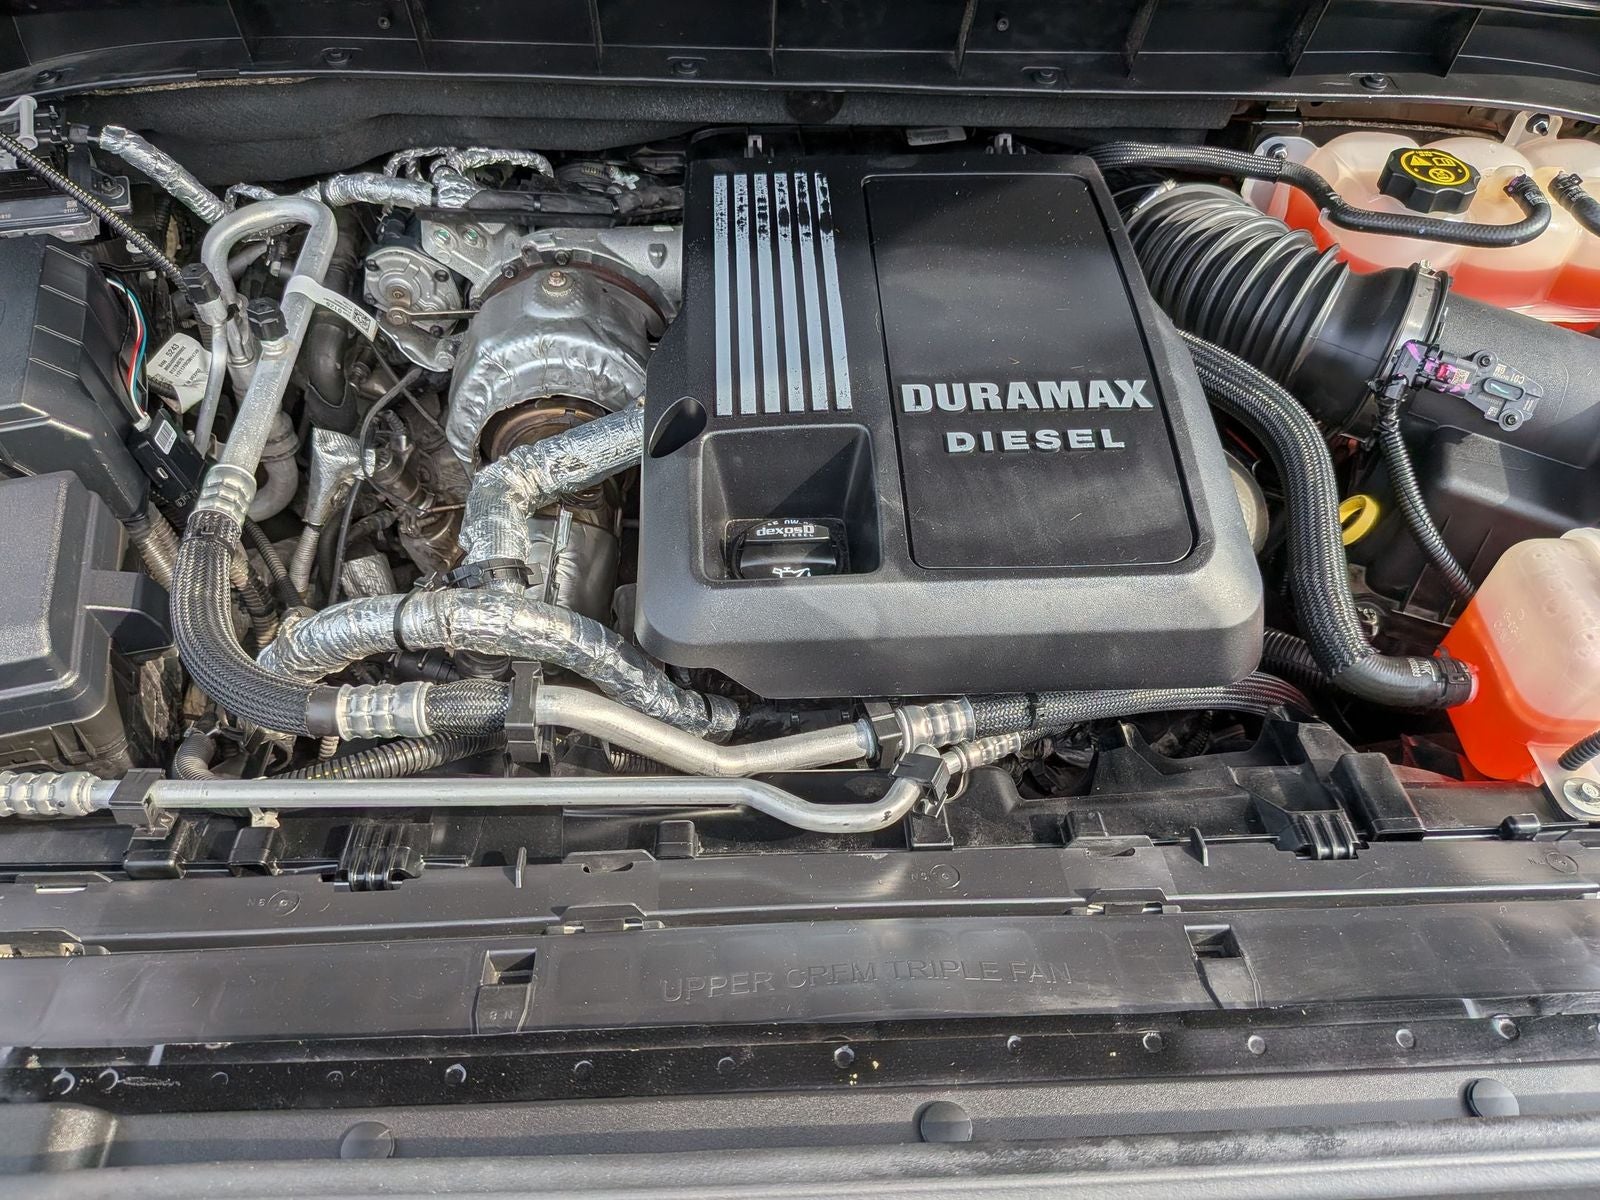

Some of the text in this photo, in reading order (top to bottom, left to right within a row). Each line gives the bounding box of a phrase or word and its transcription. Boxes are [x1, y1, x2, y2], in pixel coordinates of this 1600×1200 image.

[166, 343, 179, 357] 5243
[901, 380, 1153, 413] DURAMAX
[946, 429, 1126, 454] DIESEL
[663, 971, 776, 1002] UPPER
[886, 960, 1003, 982] TRIPLE
[1008, 961, 1073, 984] FAN
